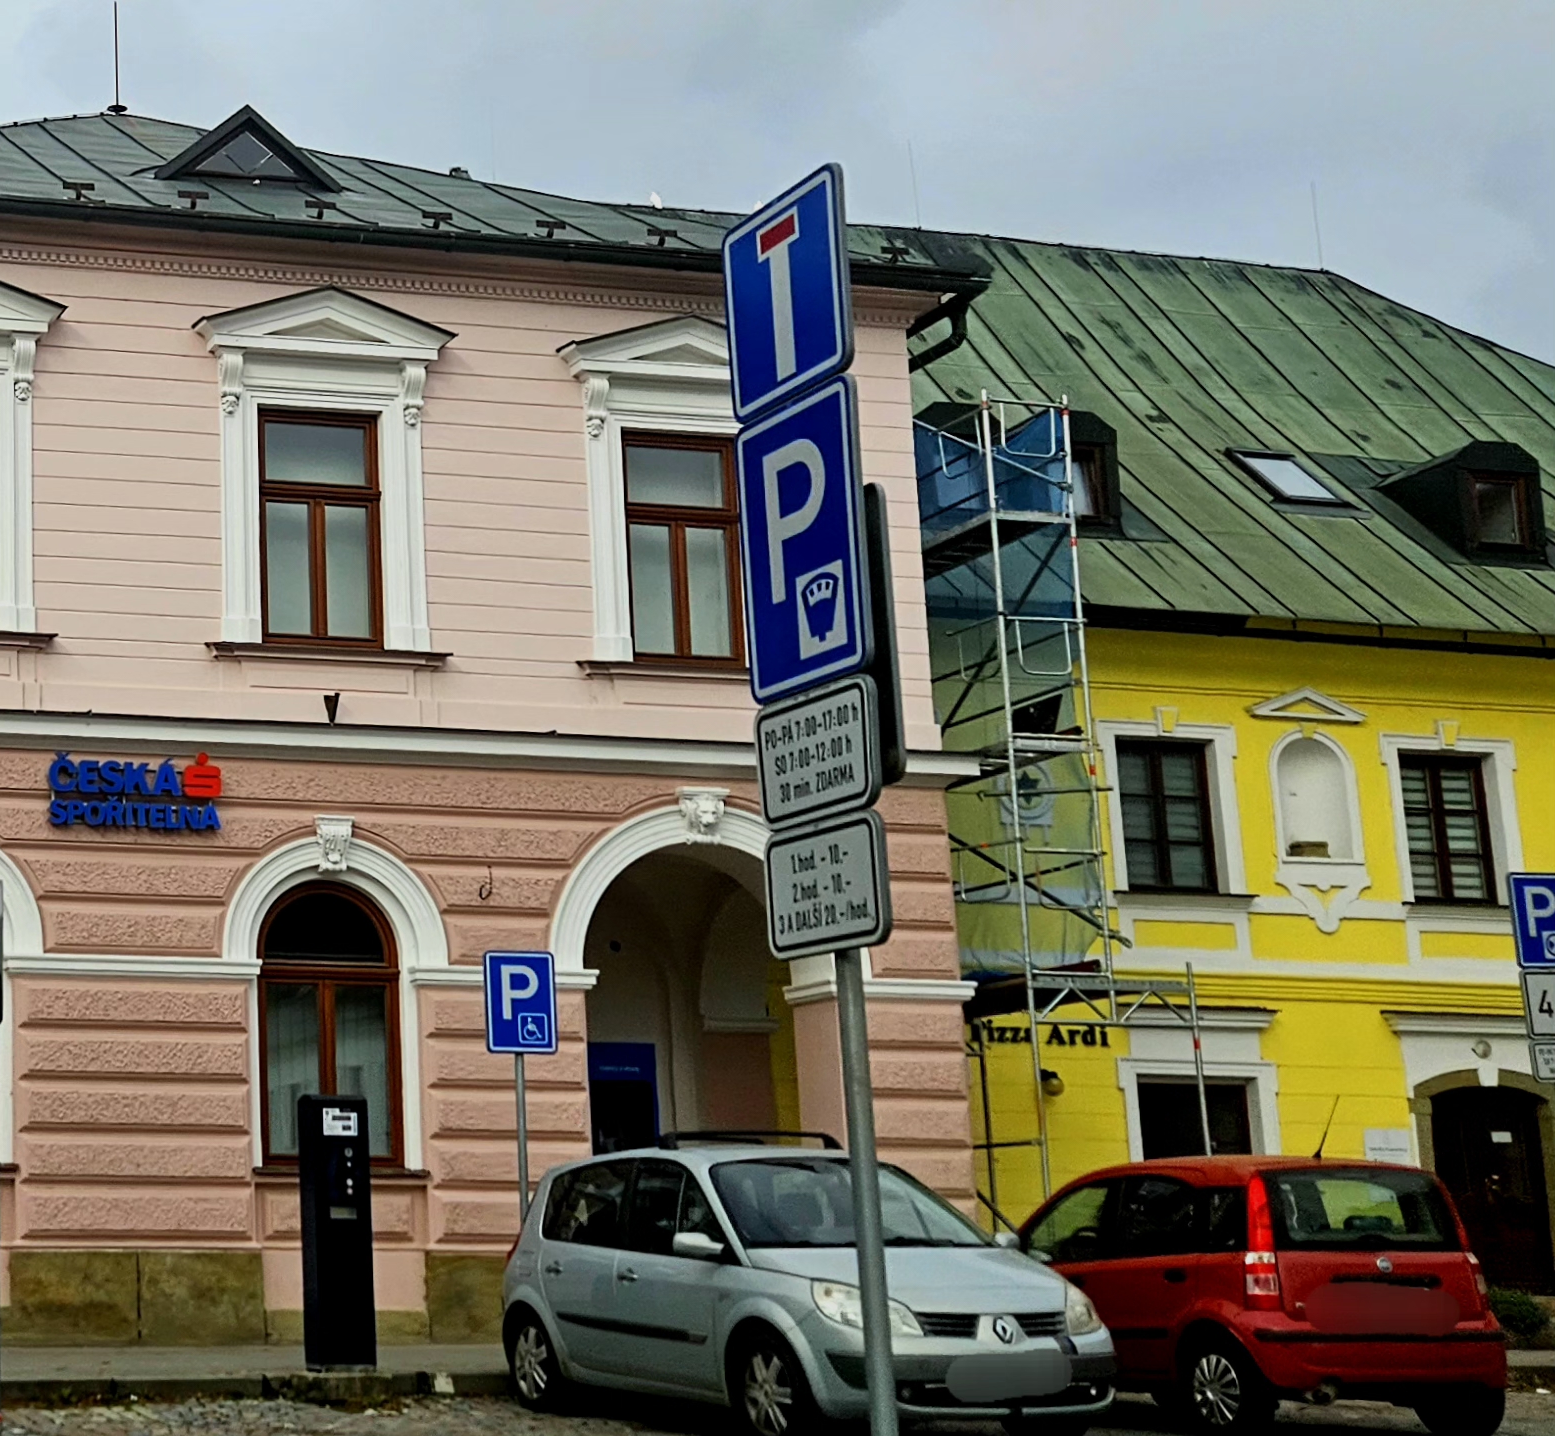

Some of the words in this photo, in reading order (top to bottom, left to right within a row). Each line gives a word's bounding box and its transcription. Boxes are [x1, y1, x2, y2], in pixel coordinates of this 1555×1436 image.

[763, 438, 826, 604] P
[765, 719, 794, 751] PO-PÁ
[795, 703, 849, 741] 7:00-17:00
[851, 702, 858, 721] h
[48, 751, 182, 796] ČESKÁ
[775, 755, 787, 776] SO
[789, 736, 843, 772] 7:00-12:00
[845, 734, 852, 754] h
[780, 782, 791, 803] 30
[815, 762, 855, 793] ZDARMA
[49, 796, 221, 830] SPOŘITELNA
[779, 914, 785, 935] 3
[787, 912, 794, 934] A
[795, 901, 822, 932] DALŠÍ
[1522, 886, 1555, 937] P
[500, 964, 539, 1020] P
[1046, 1023, 1110, 1047] Ardi
